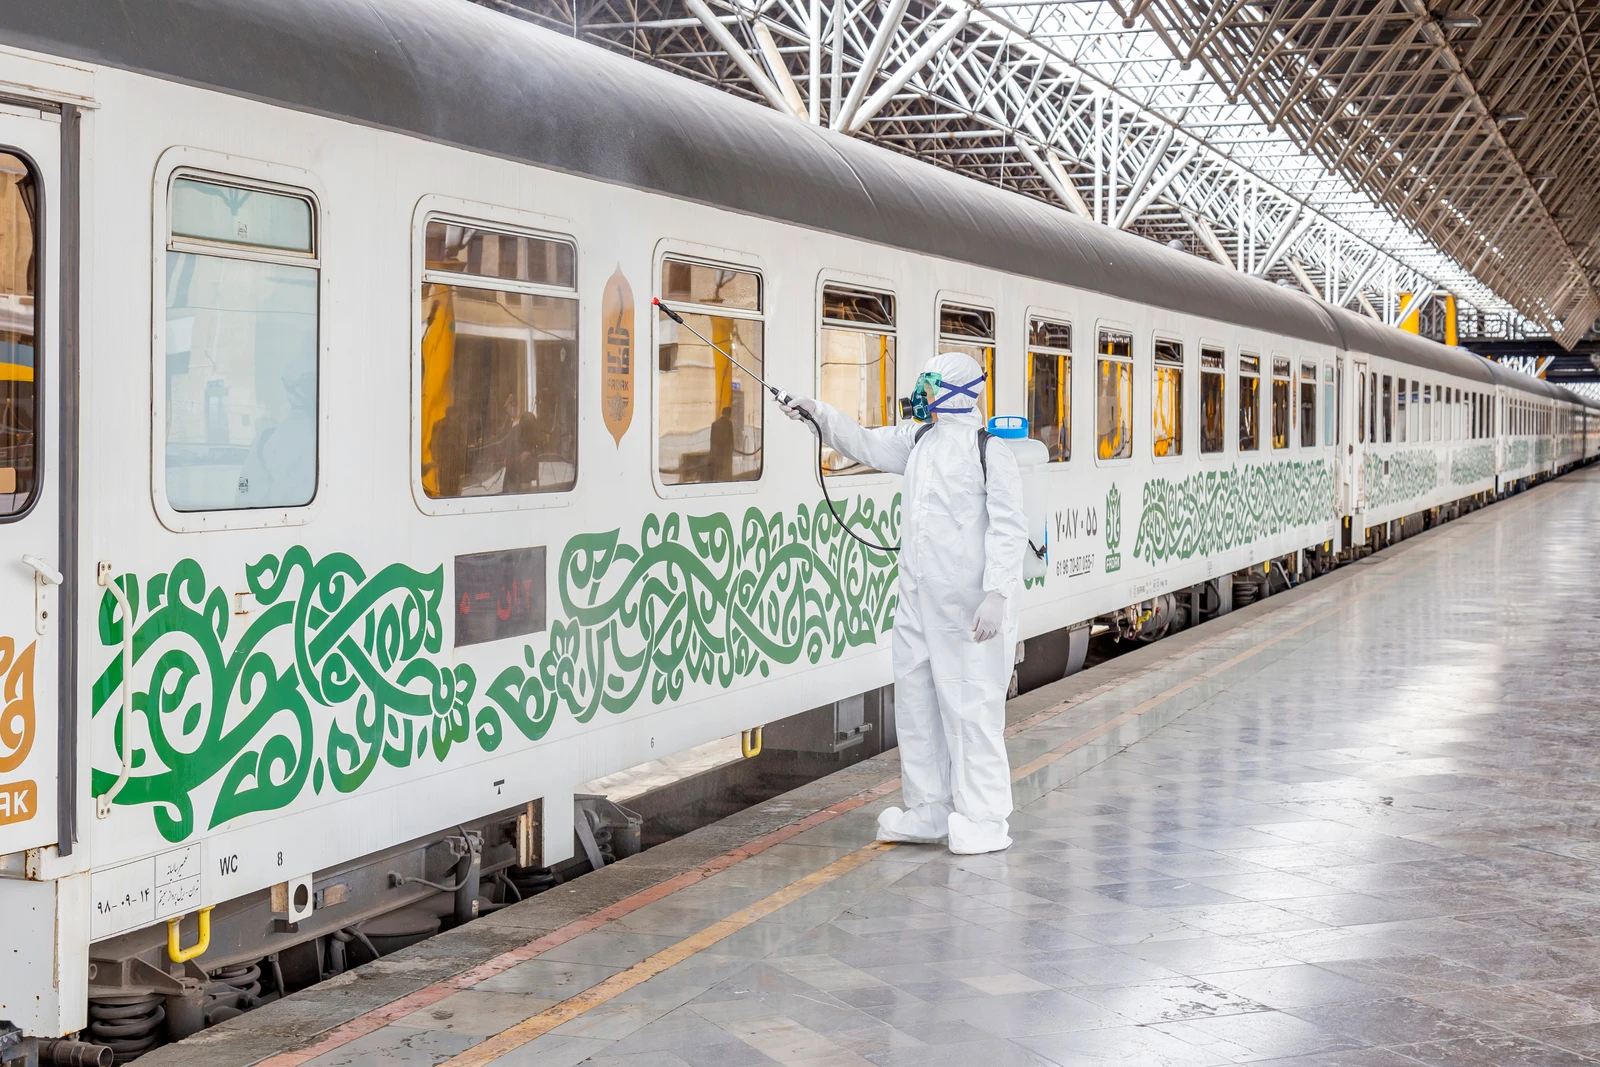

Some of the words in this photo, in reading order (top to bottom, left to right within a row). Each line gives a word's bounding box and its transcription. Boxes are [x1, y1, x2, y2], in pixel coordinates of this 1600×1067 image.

[650, 737, 655, 749] 6
[219, 854, 238, 876] WC
[277, 851, 283, 867] 8
